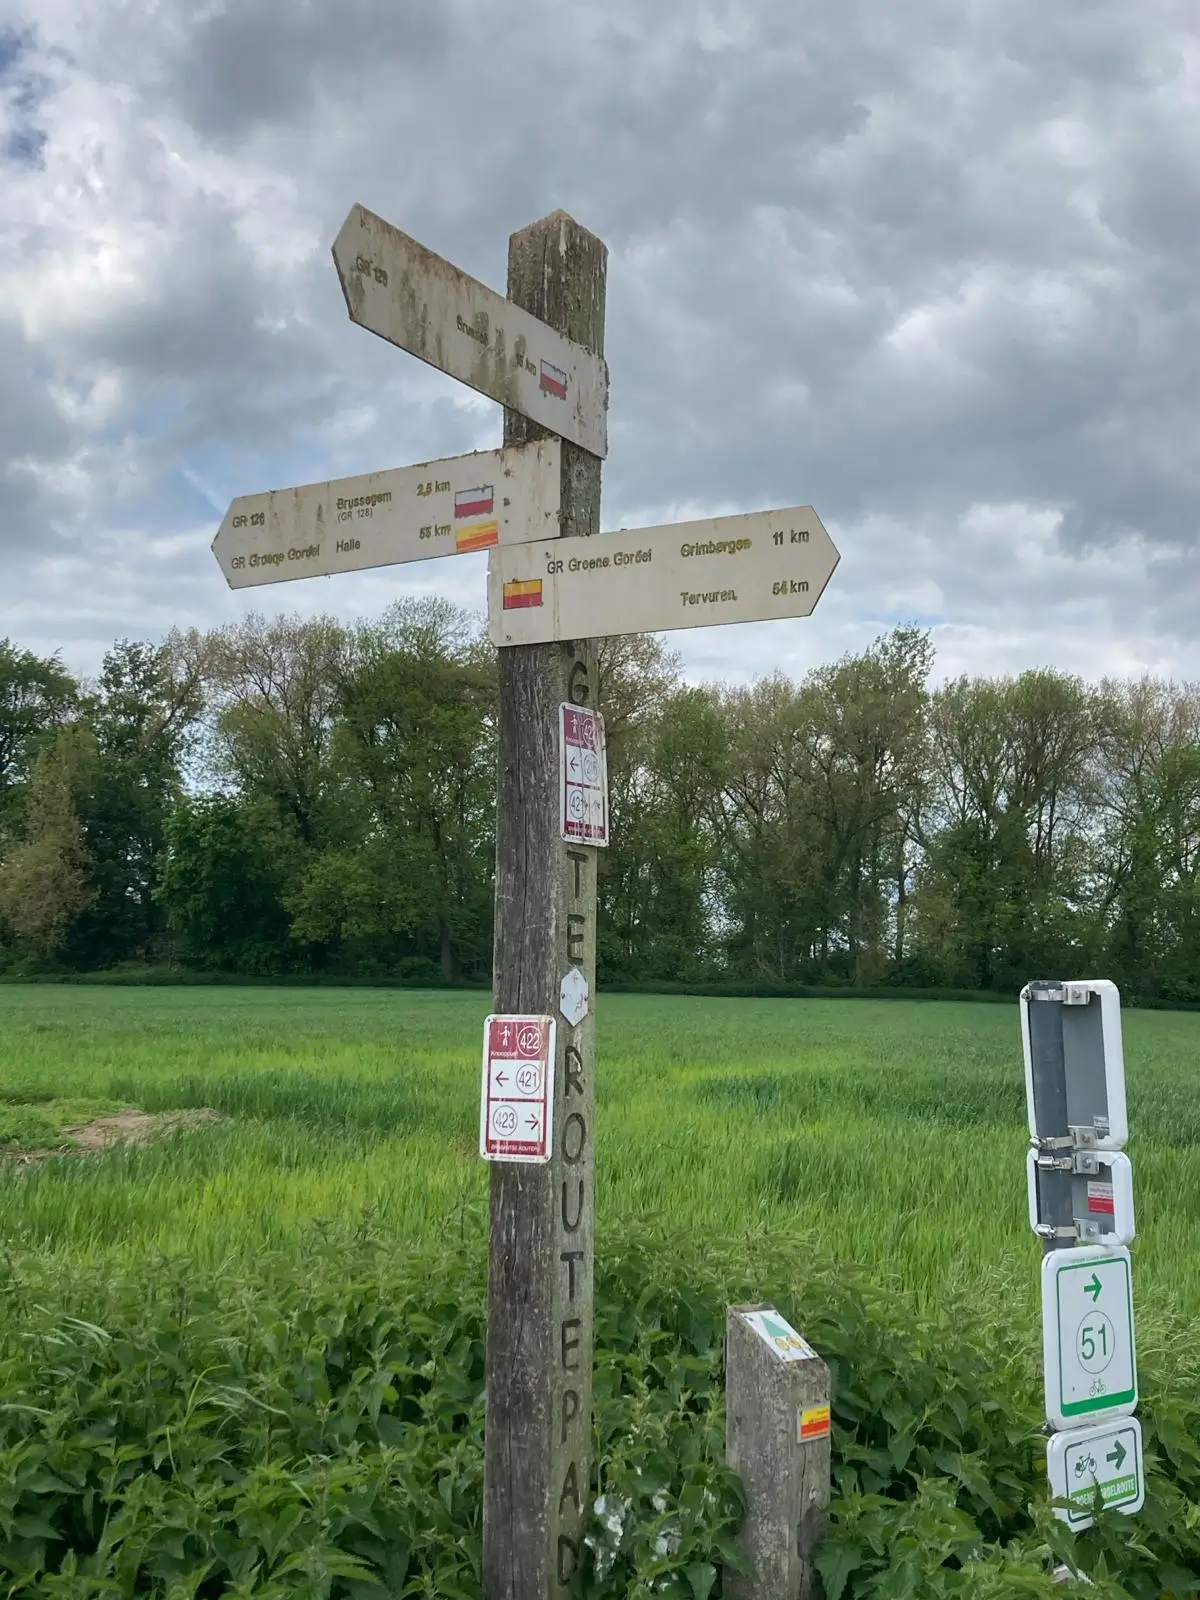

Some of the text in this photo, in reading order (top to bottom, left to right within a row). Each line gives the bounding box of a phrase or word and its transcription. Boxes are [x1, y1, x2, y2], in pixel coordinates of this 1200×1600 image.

[435, 480, 451, 493] km
[336, 491, 392, 511] Brussegem
[232, 515, 247, 528] GR
[338, 507, 373, 524] (GR 128)
[434, 523, 452, 537] km
[773, 529, 810, 545] 11 km
[680, 538, 752, 557] Grimbergen
[231, 556, 246, 569] GR
[547, 548, 652, 574] GR Groene Gordel
[790, 580, 809, 593] km
[680, 589, 738, 606] Tervuren
[520, 1032, 540, 1049] 422
[518, 1070, 537, 1088] 421
[495, 1111, 515, 1129] 423
[1080, 1323, 1107, 1360] 51
